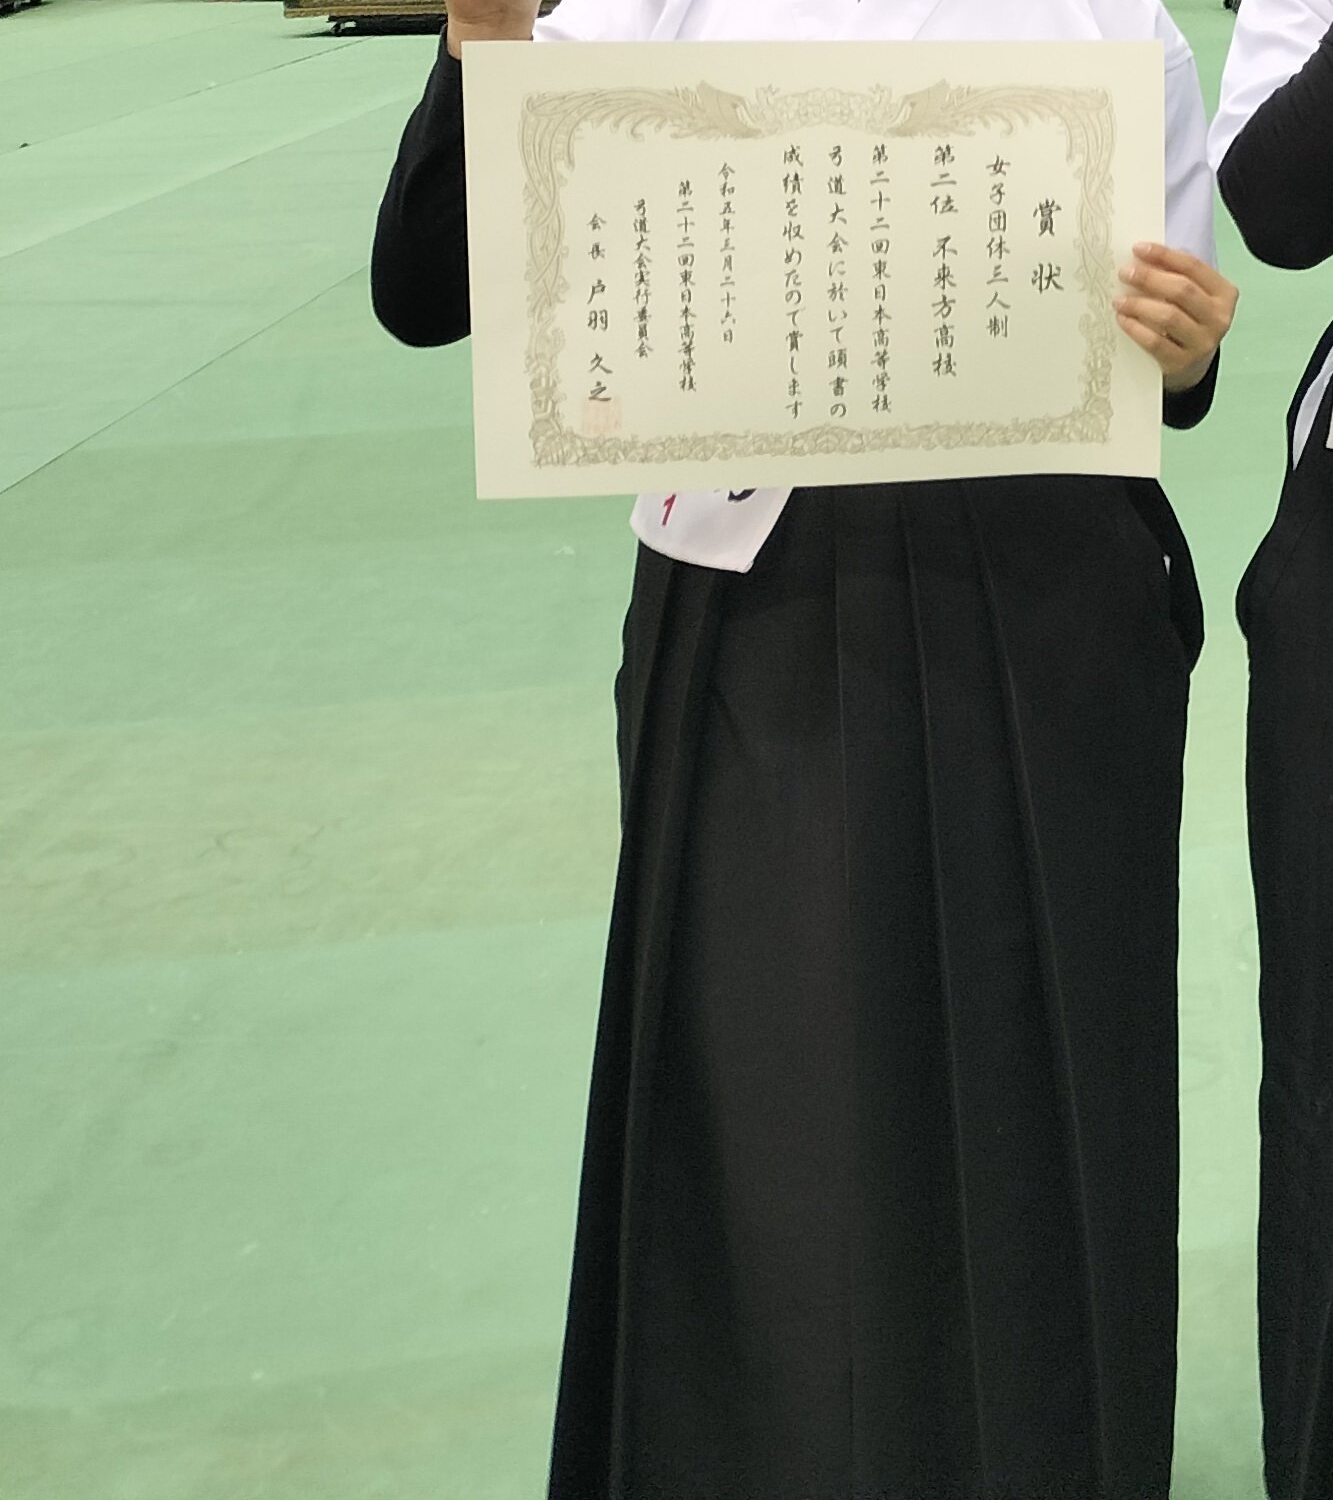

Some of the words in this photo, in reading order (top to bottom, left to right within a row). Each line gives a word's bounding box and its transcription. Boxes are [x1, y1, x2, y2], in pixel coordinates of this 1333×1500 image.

[717, 161, 738, 345] 令和五年三月二十六日
[929, 143, 959, 216] 第二位
[984, 154, 1012, 339] 女子団体三人制
[1030, 197, 1065, 295] 賞状
[675, 179, 698, 393] 第二十二回東日本高等学校
[781, 143, 807, 421] 成績を収めたので賞します
[868, 143, 893, 415] 第二十二回東日本高等学校
[931, 234, 959, 379] 不来方高校
[661, 492, 677, 527] 1
